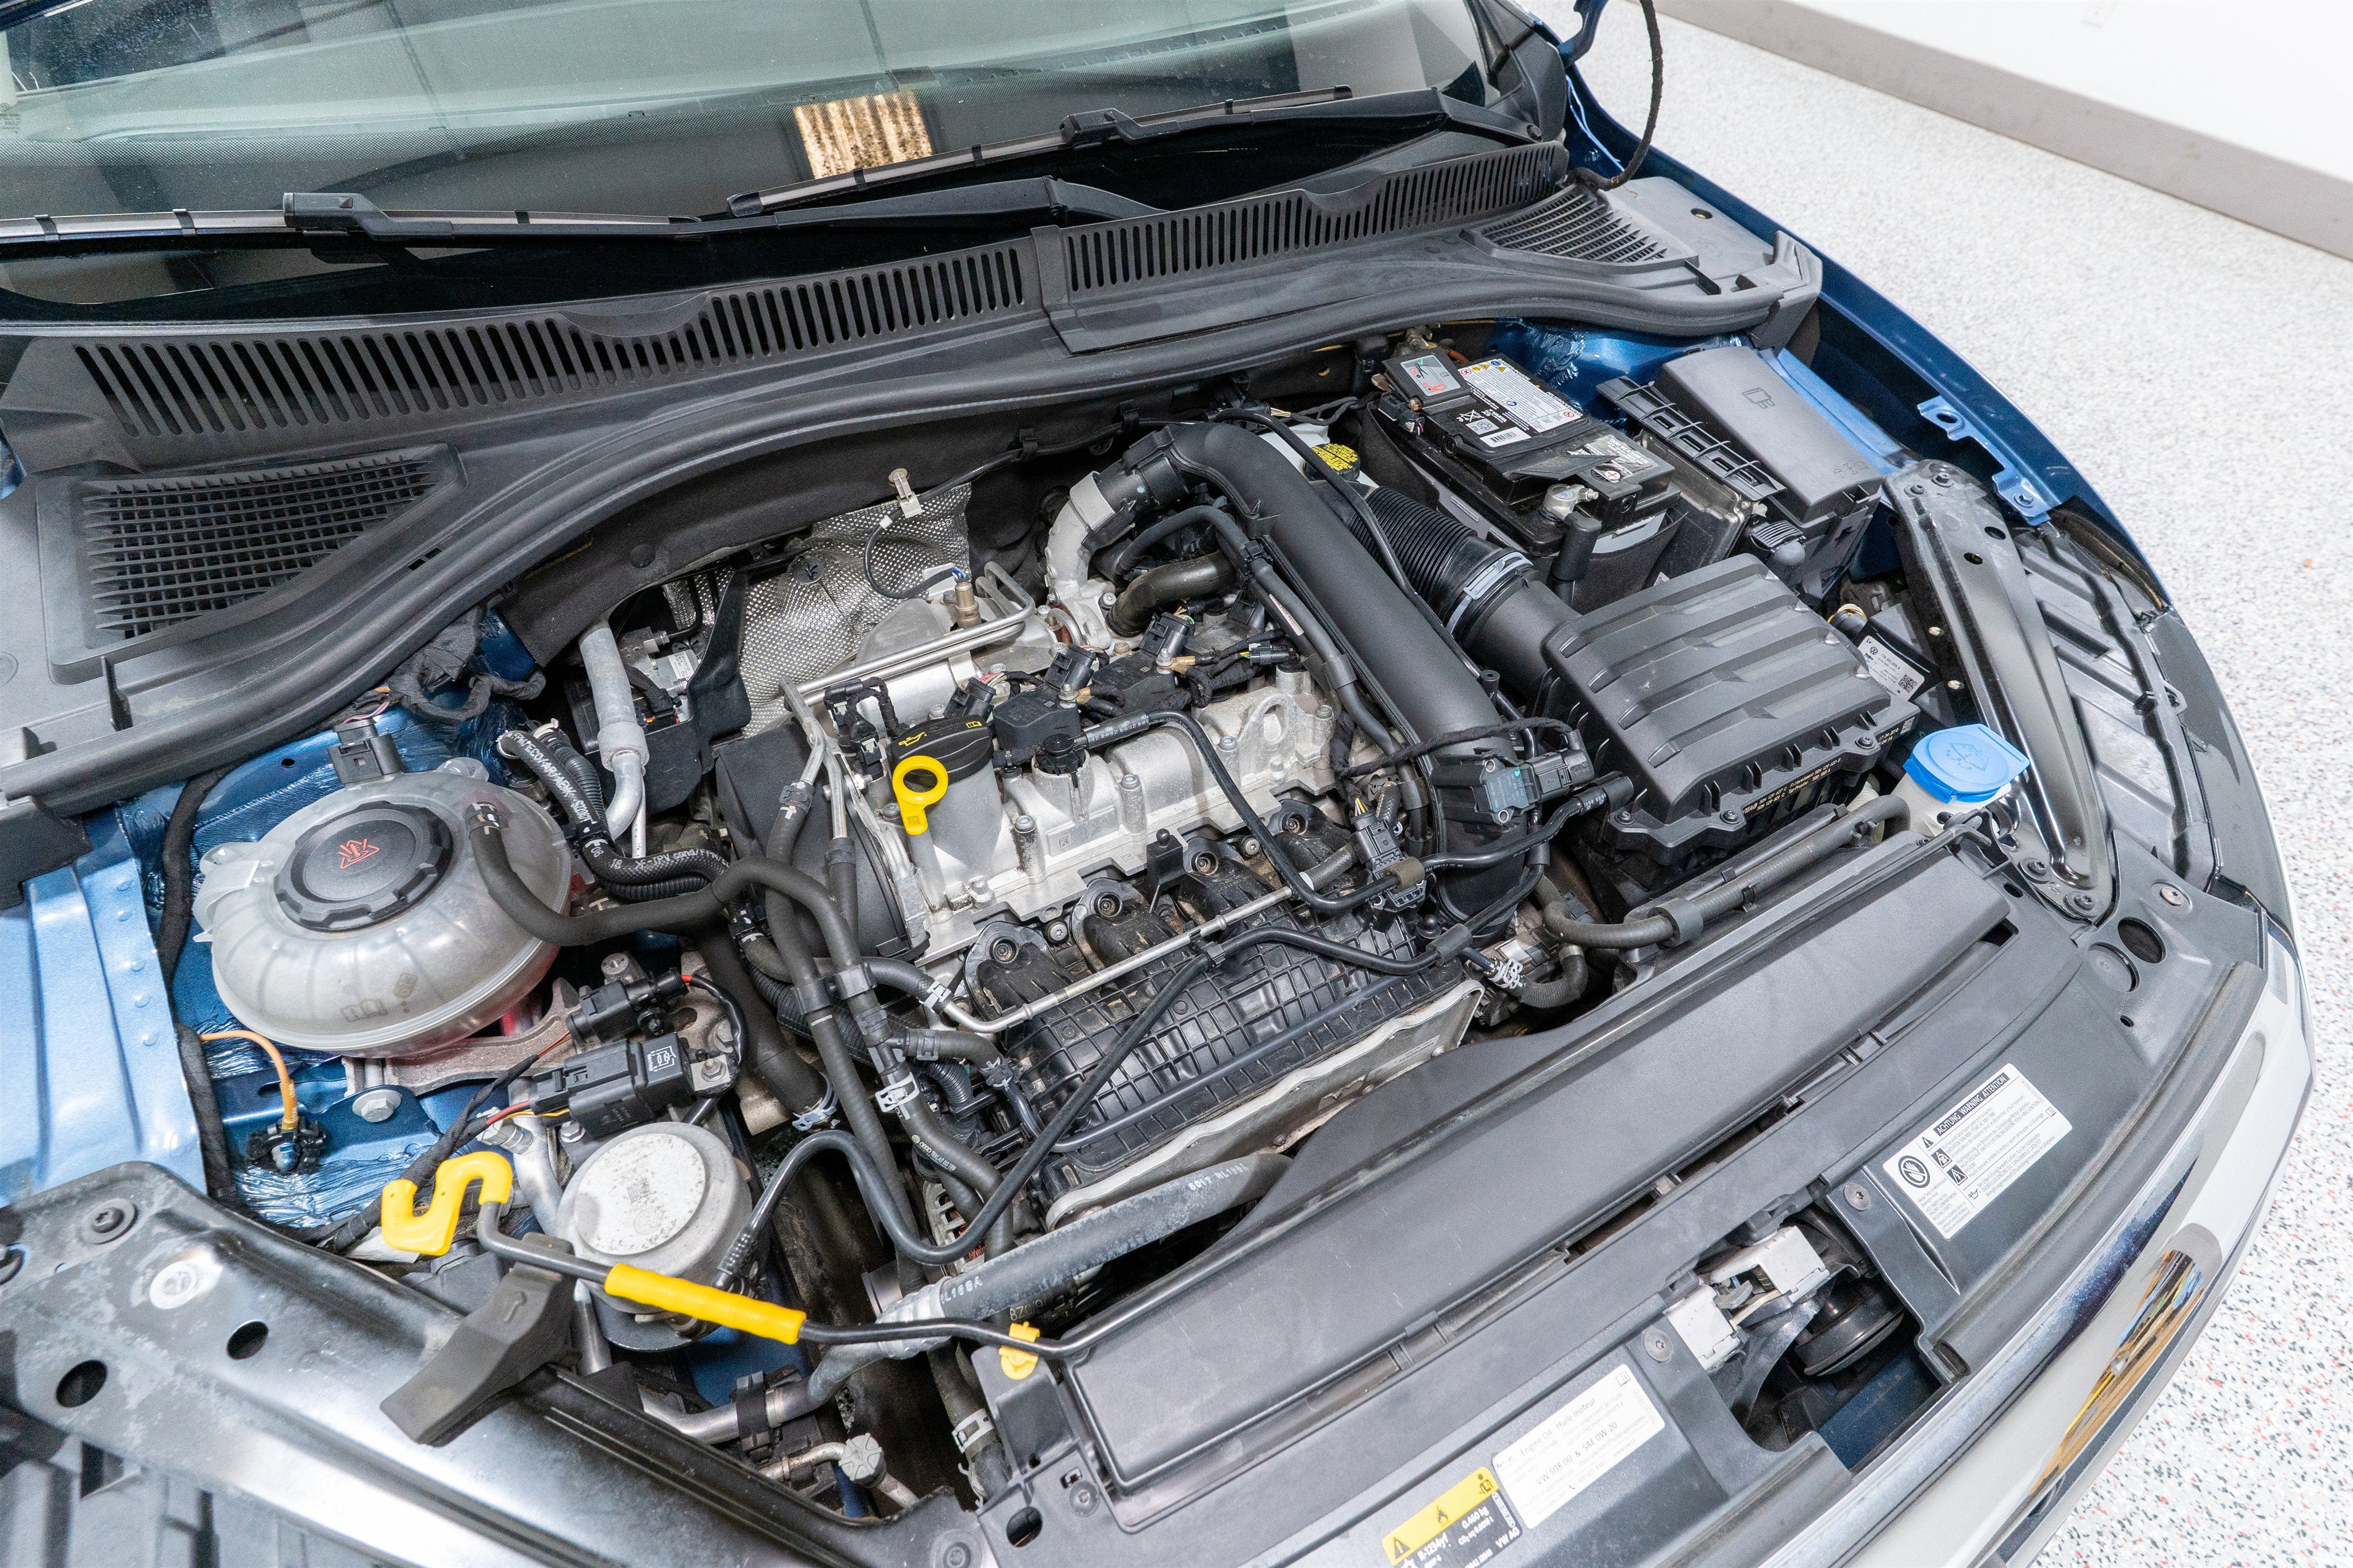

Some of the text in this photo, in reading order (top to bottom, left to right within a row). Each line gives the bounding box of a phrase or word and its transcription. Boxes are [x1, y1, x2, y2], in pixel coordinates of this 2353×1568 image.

[1936, 1112, 1962, 1135] ACHTUNG
[1959, 1094, 1983, 1116] WARNING
[1980, 1075, 2007, 1098] ATTENTION
[1946, 1140, 1961, 1154] RADIATOR
[1964, 1130, 1973, 1138] MAY
[1970, 1124, 1980, 1133] START
[1953, 1141, 1970, 1156] ventilateur
[1970, 1128, 1985, 1141] radiateur
[1982, 1123, 1991, 1131] peut
[1960, 1160, 1970, 1169] HIGH
[1979, 1141, 1992, 1153] SWITCH
[1994, 1128, 2007, 1140] ENGINE
[2004, 1121, 2016, 1131] BEFORE
[2013, 1109, 2029, 1123] TOUCHING
[2026, 1099, 2040, 1112] IGNITION
[929, 1150, 944, 1163] TEKLAS
[1968, 1168, 1979, 1178] Haute
[1998, 1141, 2010, 1152] moteur
[2007, 1135, 2017, 1144] avant
[2018, 1123, 2030, 1134] toucher
[1996, 1159, 2009, 1171] besteht
[2006, 1151, 2018, 1163] Gefahr
[1981, 1176, 1999, 1193] OVERFILLED
[1996, 1167, 2009, 1180] ENGINE
[2011, 1157, 2020, 1167] CAN
[2016, 1148, 2031, 1161] DAMAGE
[1985, 1180, 2004, 1198] Remplissage
[1924, 1205, 1933, 1213] HOT
[1930, 1199, 1940, 1208] PARTS
[1928, 1206, 1940, 1217] ENGINE
[1931, 1208, 1945, 1221] MOVING
[1940, 1212, 1959, 1231] compartiment
[1519, 1396, 1596, 1458] Engine Oil Huile moteur
[1535, 1472, 1550, 1486] VW
[1548, 1461, 1563, 1476] 508
[1561, 1454, 1573, 1466] 00
[1573, 1449, 1581, 1458] &
[1581, 1437, 1596, 1452] SAE
[1460, 1511, 1482, 1530] 0.460
[1476, 1504, 1491, 1519] kg
[1415, 1531, 1452, 1563] R-1234yf
[1494, 1525, 1521, 1549] VW AG
